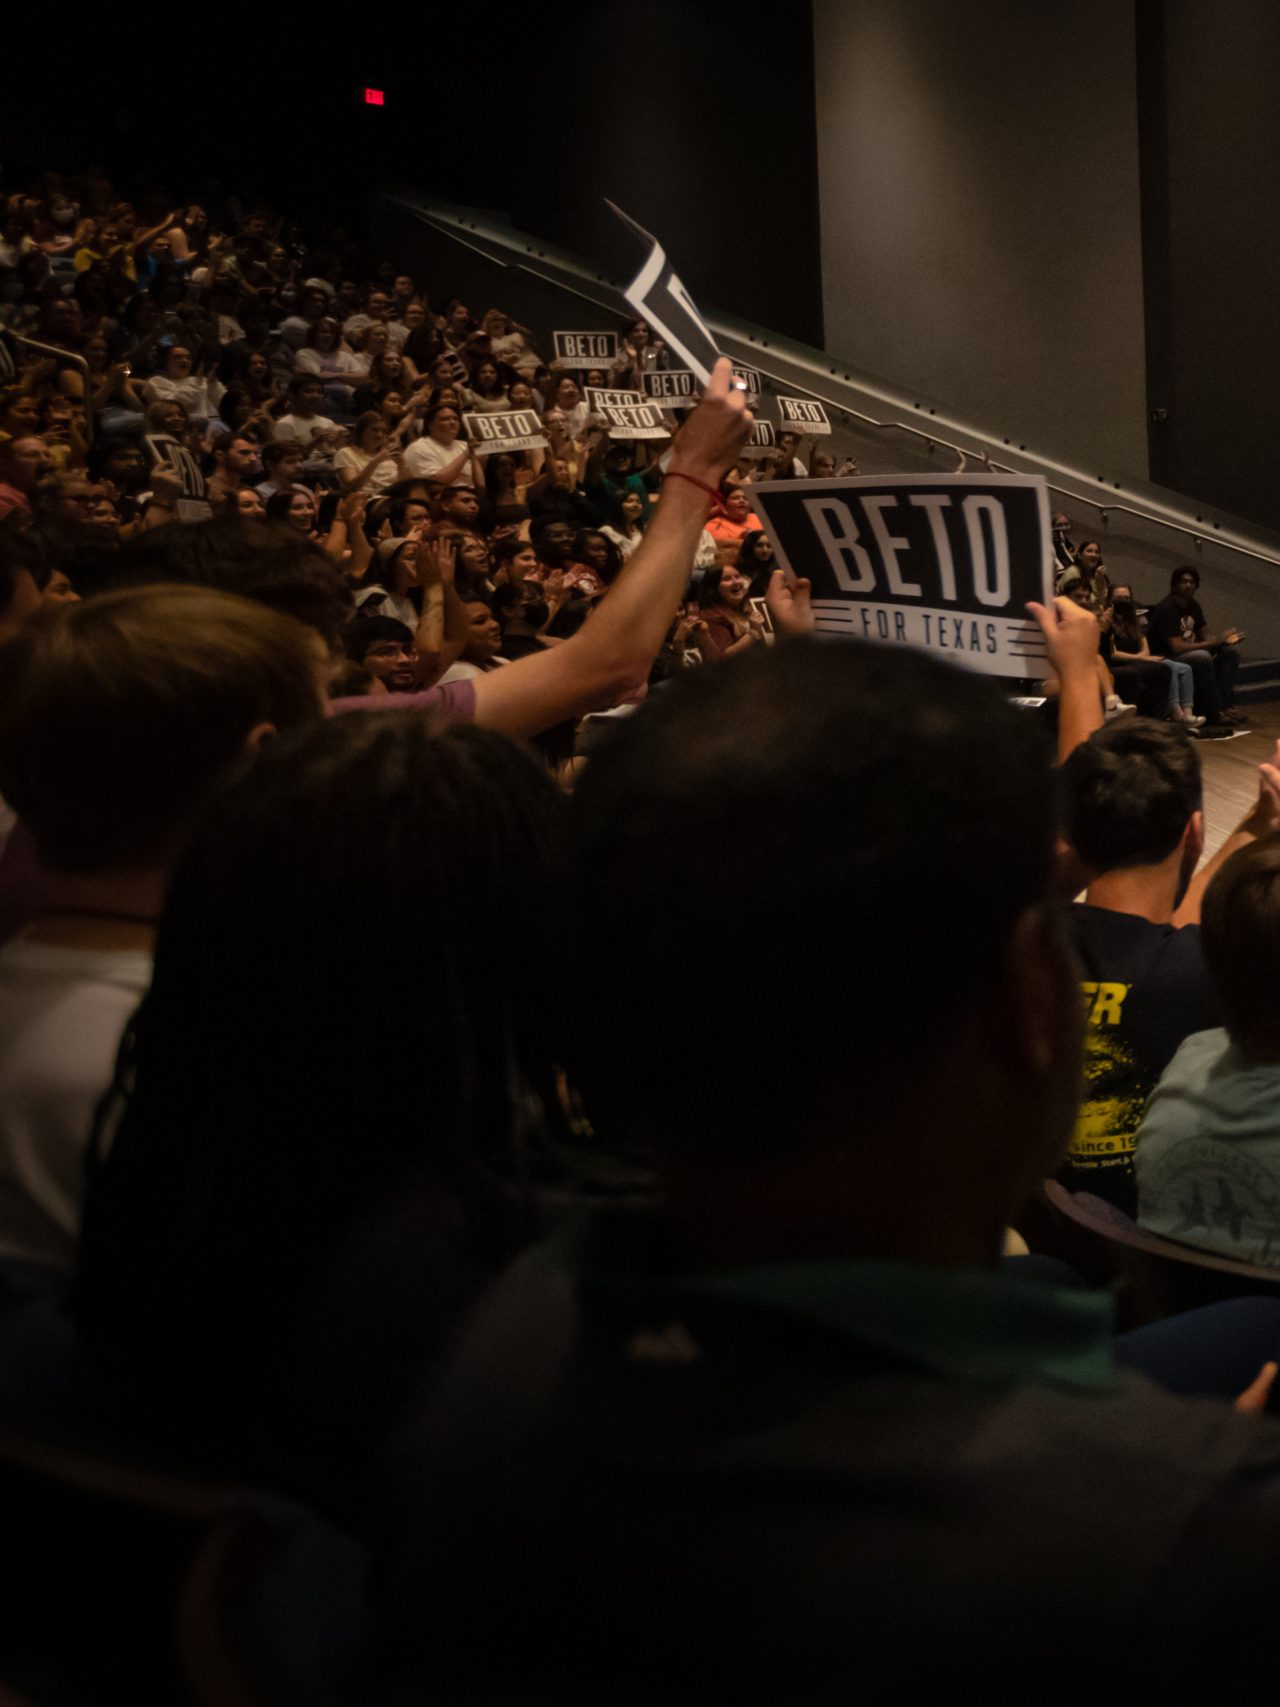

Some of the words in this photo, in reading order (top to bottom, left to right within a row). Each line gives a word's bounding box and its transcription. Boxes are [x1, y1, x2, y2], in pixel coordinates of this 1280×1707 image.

[564, 335, 608, 357] BETO
[650, 374, 690, 397] BETO
[607, 407, 656, 427] BETO
[785, 401, 821, 422] BETO
[477, 414, 532, 440] BETO
[802, 494, 1011, 607] BETO
[861, 608, 906, 641] FOR
[922, 614, 997, 653] TEXAS
